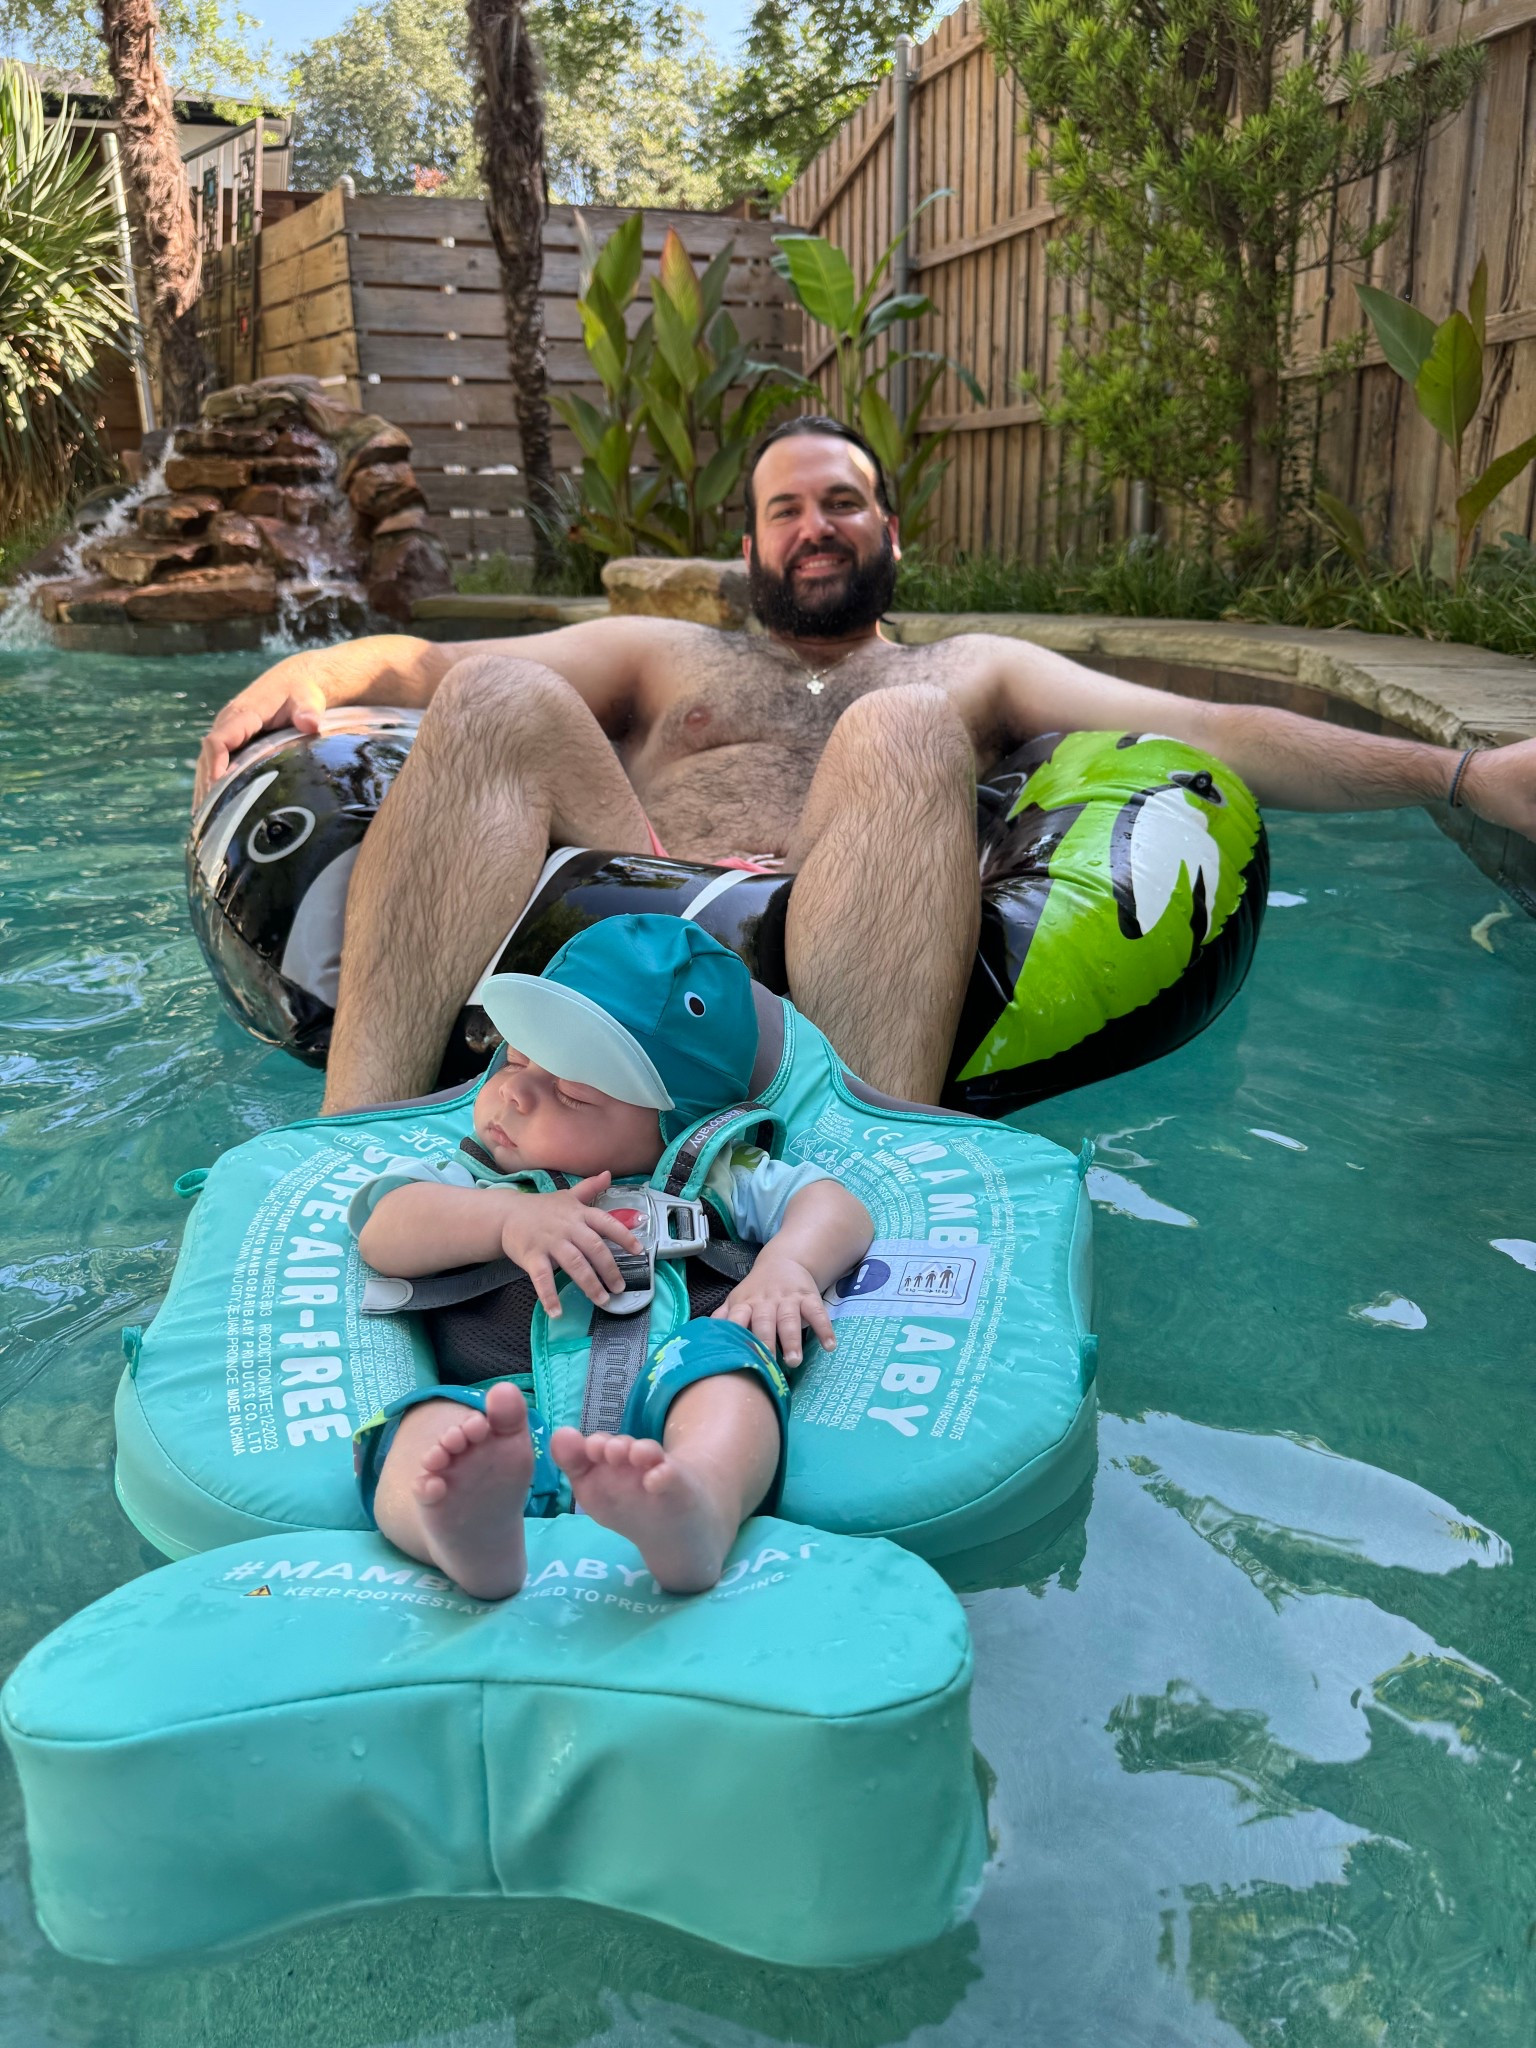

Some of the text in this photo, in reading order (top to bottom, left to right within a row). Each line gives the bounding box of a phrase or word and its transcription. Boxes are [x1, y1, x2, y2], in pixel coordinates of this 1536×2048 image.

[287, 1190, 307, 1207] BABY
[253, 1201, 283, 1244] ZHEJIANG
[277, 1209, 293, 1231] FLOAT
[268, 1235, 283, 1254] ITEM
[280, 1235, 353, 1448] AIR-FREE
[842, 1330, 856, 1341] AND
[867, 1324, 882, 1340] UNTER
[834, 1342, 850, 1360] UNDER
[842, 1350, 860, 1368] WHILE
[856, 1340, 876, 1366] AUFSICHT
[825, 1360, 842, 1379] ADULT
[850, 1366, 865, 1381] EINES
[830, 1370, 852, 1392] DEVICE
[227, 1388, 240, 1413] MADE
[802, 1380, 835, 1422] SUPERVISION.
[827, 1382, 858, 1426] ERWACHSENEN.
[229, 1415, 241, 1425] IN
[815, 1409, 833, 1424] USE.
[229, 1426, 245, 1455] CHINA
[247, 1432, 262, 1453] LTD
[284, 1586, 341, 1597] KEEP
[344, 1589, 456, 1610] FOOTREST
[573, 1588, 599, 1602] TO
